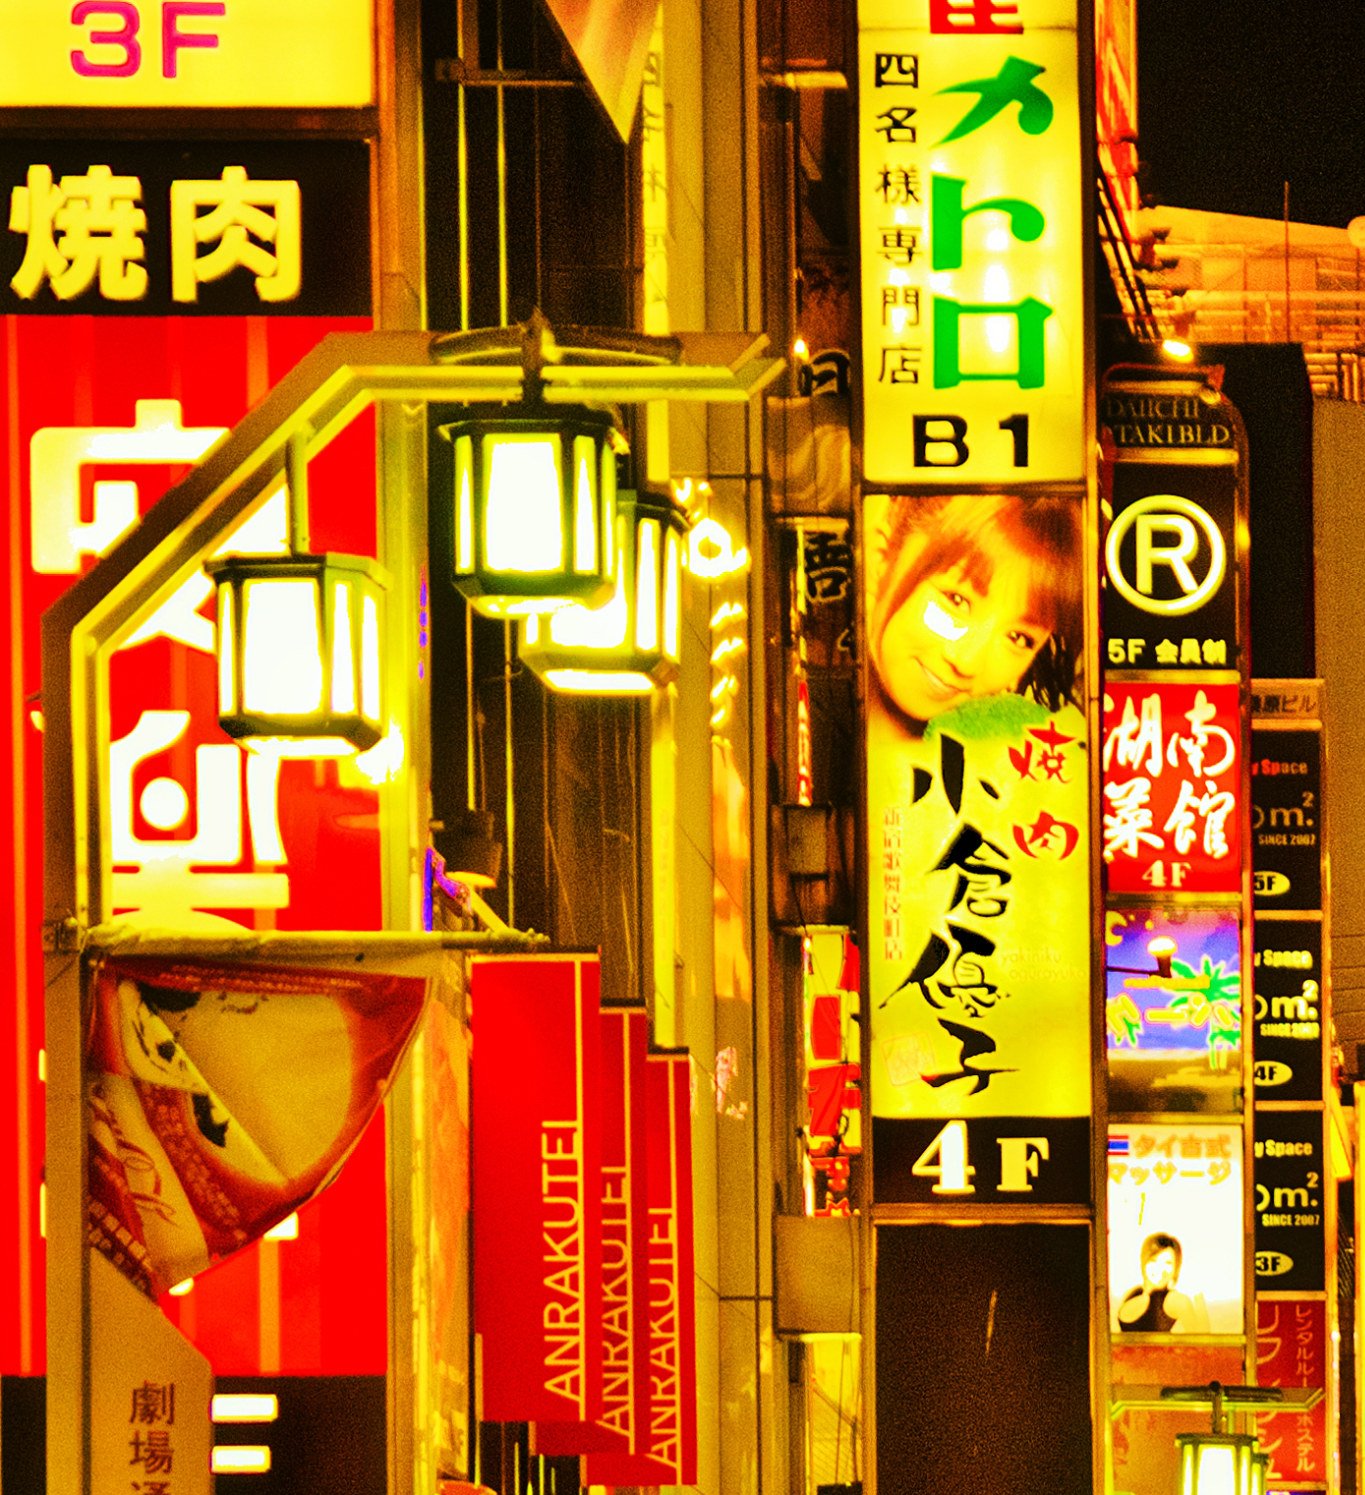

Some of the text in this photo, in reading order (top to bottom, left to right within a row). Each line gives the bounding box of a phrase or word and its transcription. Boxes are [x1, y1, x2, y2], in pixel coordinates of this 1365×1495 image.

[70, 1, 226, 78] 3F
[9, 164, 301, 302] 焼肉
[875, 53, 922, 385] 四名様専門店
[912, 414, 1030, 468] B1
[1108, 639, 1146, 664] 5F
[1142, 862, 1192, 886] 4F
[912, 1120, 1049, 1195] 4F
[542, 1117, 578, 1402] ANRAKUTEI
[599, 1166, 627, 1437] ANRAKUTEI
[647, 1205, 675, 1468] ANRAKUTEI
